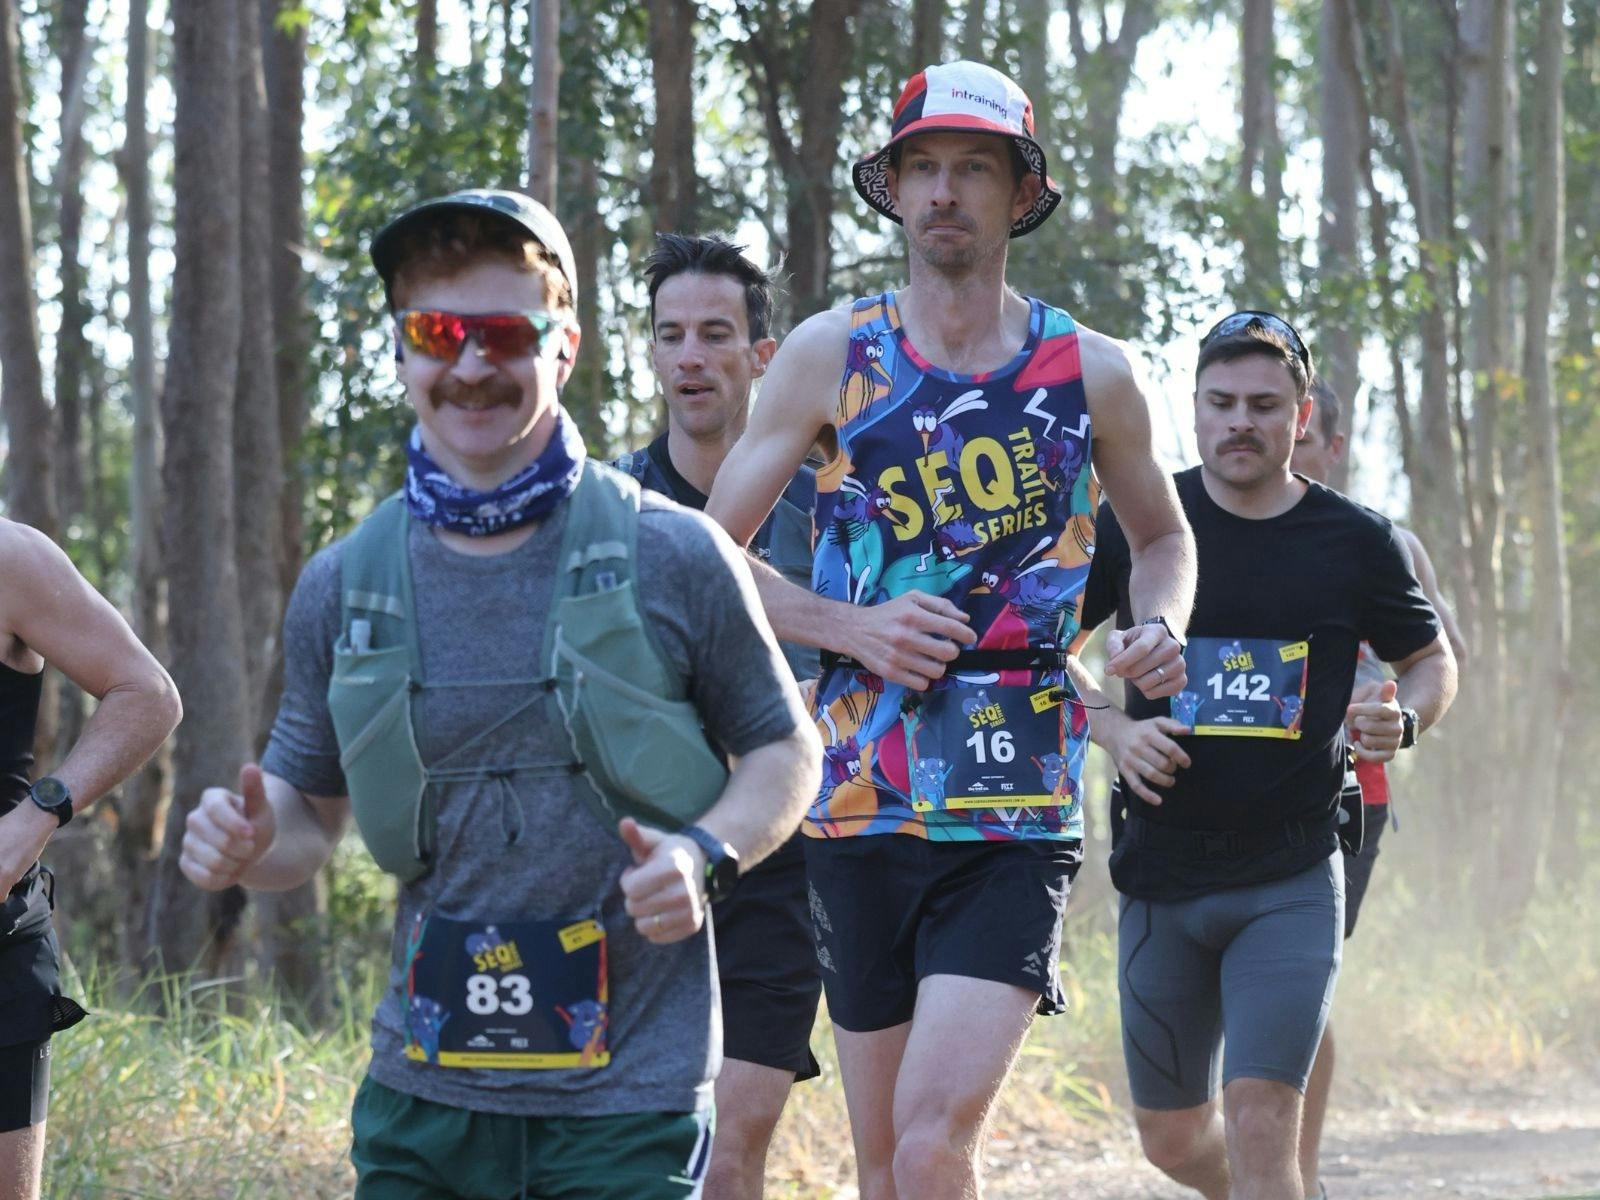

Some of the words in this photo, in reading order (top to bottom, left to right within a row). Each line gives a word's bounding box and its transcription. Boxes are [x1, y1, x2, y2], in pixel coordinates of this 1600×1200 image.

[951, 88, 1008, 119] intraining
[1008, 426, 1045, 504] TRAIL
[877, 436, 1021, 542] SEQ
[974, 503, 1048, 544] SERIES
[1207, 673, 1270, 701] 142
[969, 706, 998, 728] SEQ
[966, 730, 1016, 764] 16
[473, 946, 511, 972] SEQ
[466, 973, 534, 1016] 83
